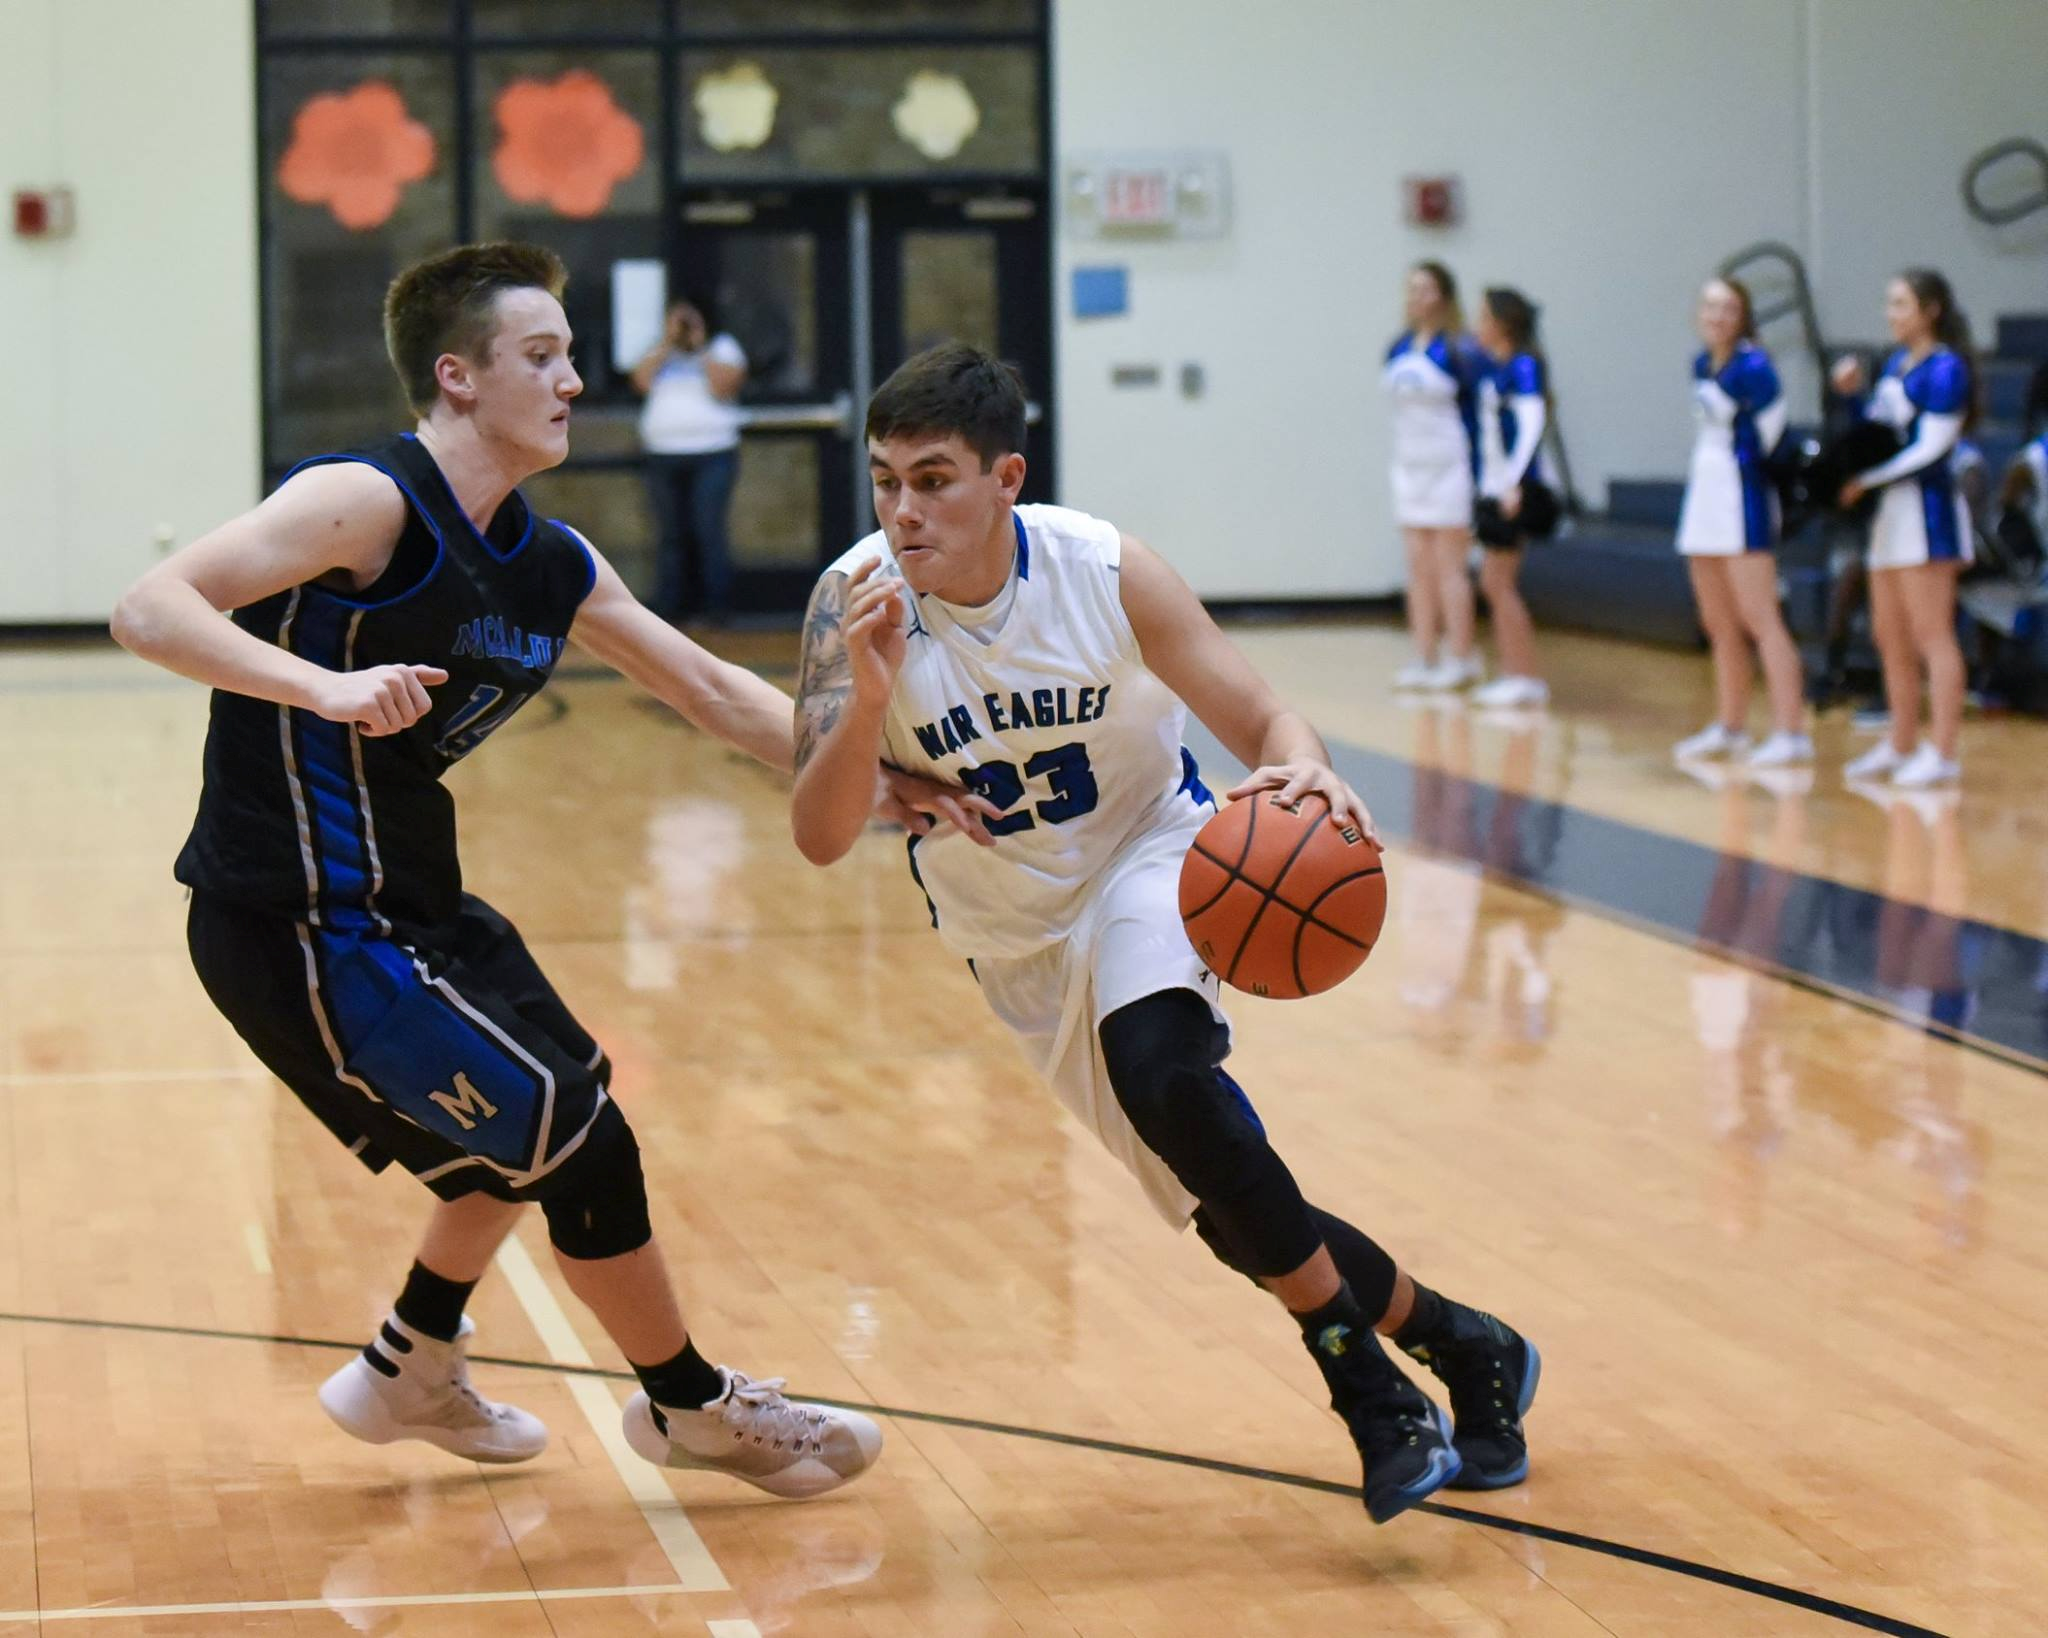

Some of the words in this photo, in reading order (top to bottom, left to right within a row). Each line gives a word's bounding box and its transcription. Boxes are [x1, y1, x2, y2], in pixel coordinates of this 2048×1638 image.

[912, 704, 982, 761] WAR
[983, 685, 1112, 732] EAGLES
[957, 742, 1099, 837] 23
[427, 1071, 499, 1130] M
